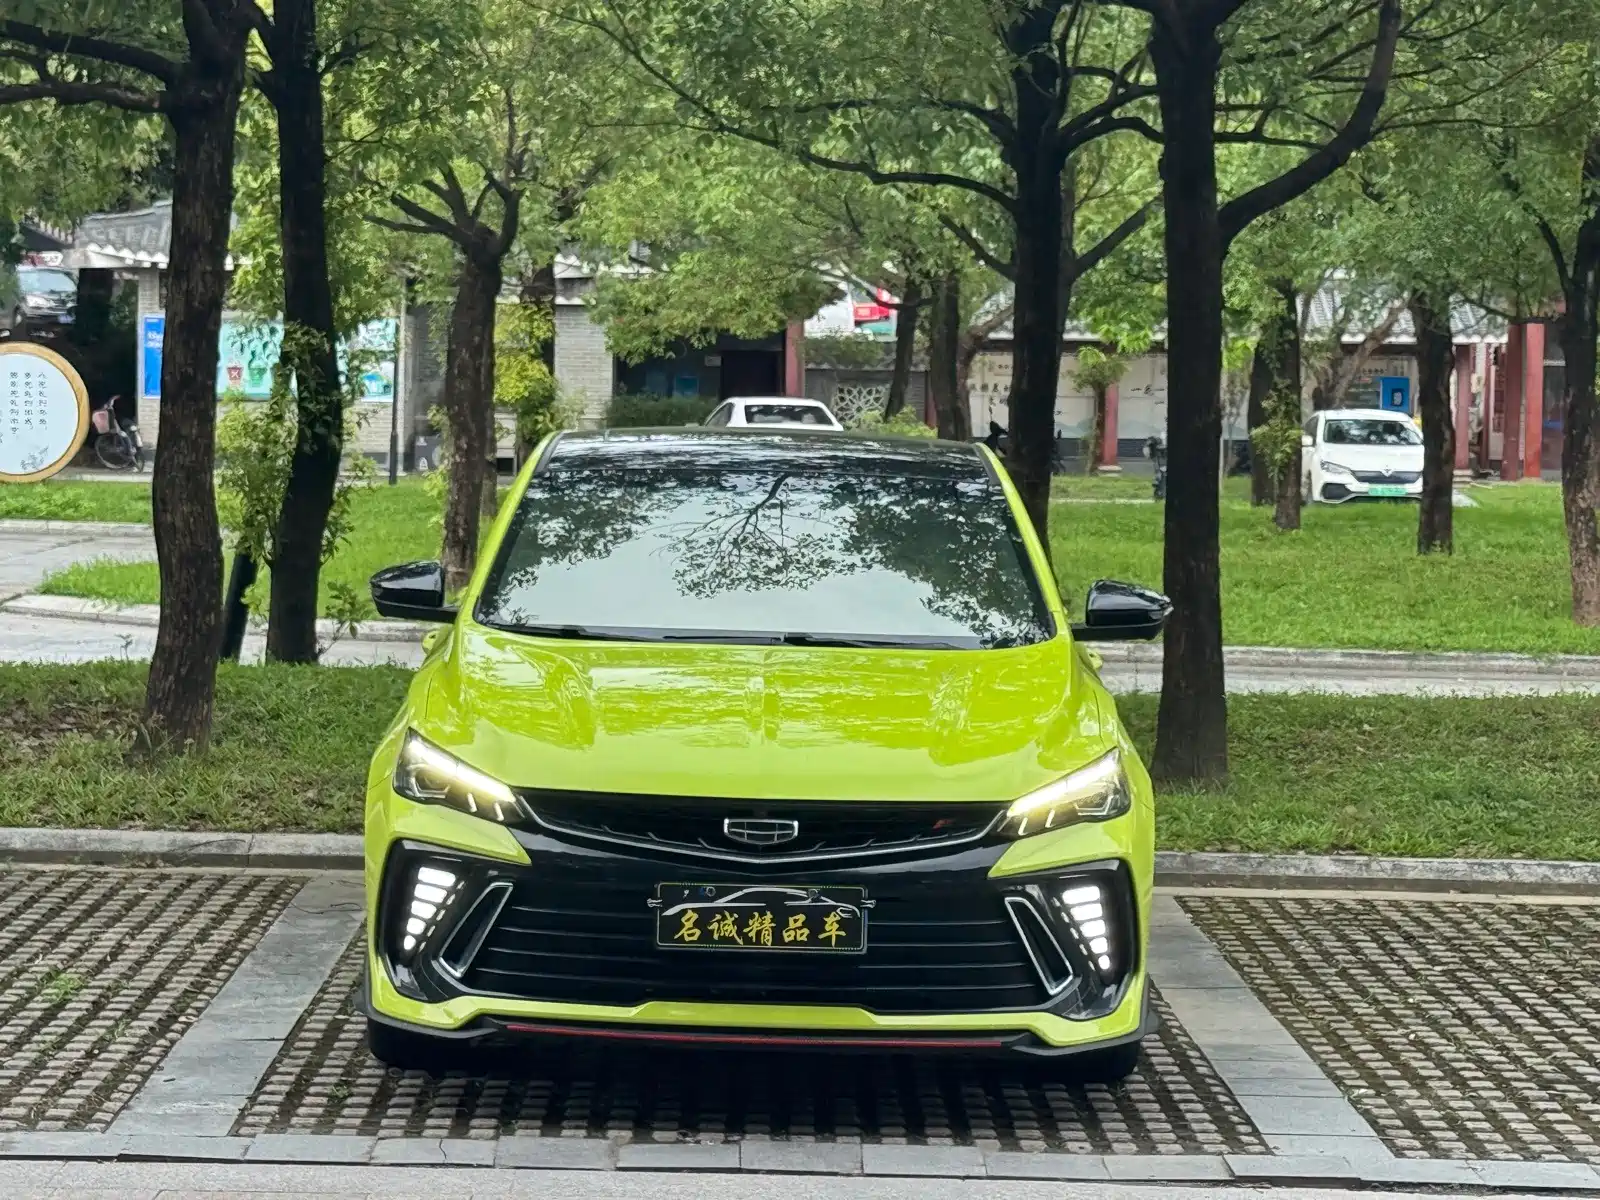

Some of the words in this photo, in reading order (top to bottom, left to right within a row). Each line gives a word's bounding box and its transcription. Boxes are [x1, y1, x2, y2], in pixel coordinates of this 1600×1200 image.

[674, 909, 847, 948] 名诚精品车
